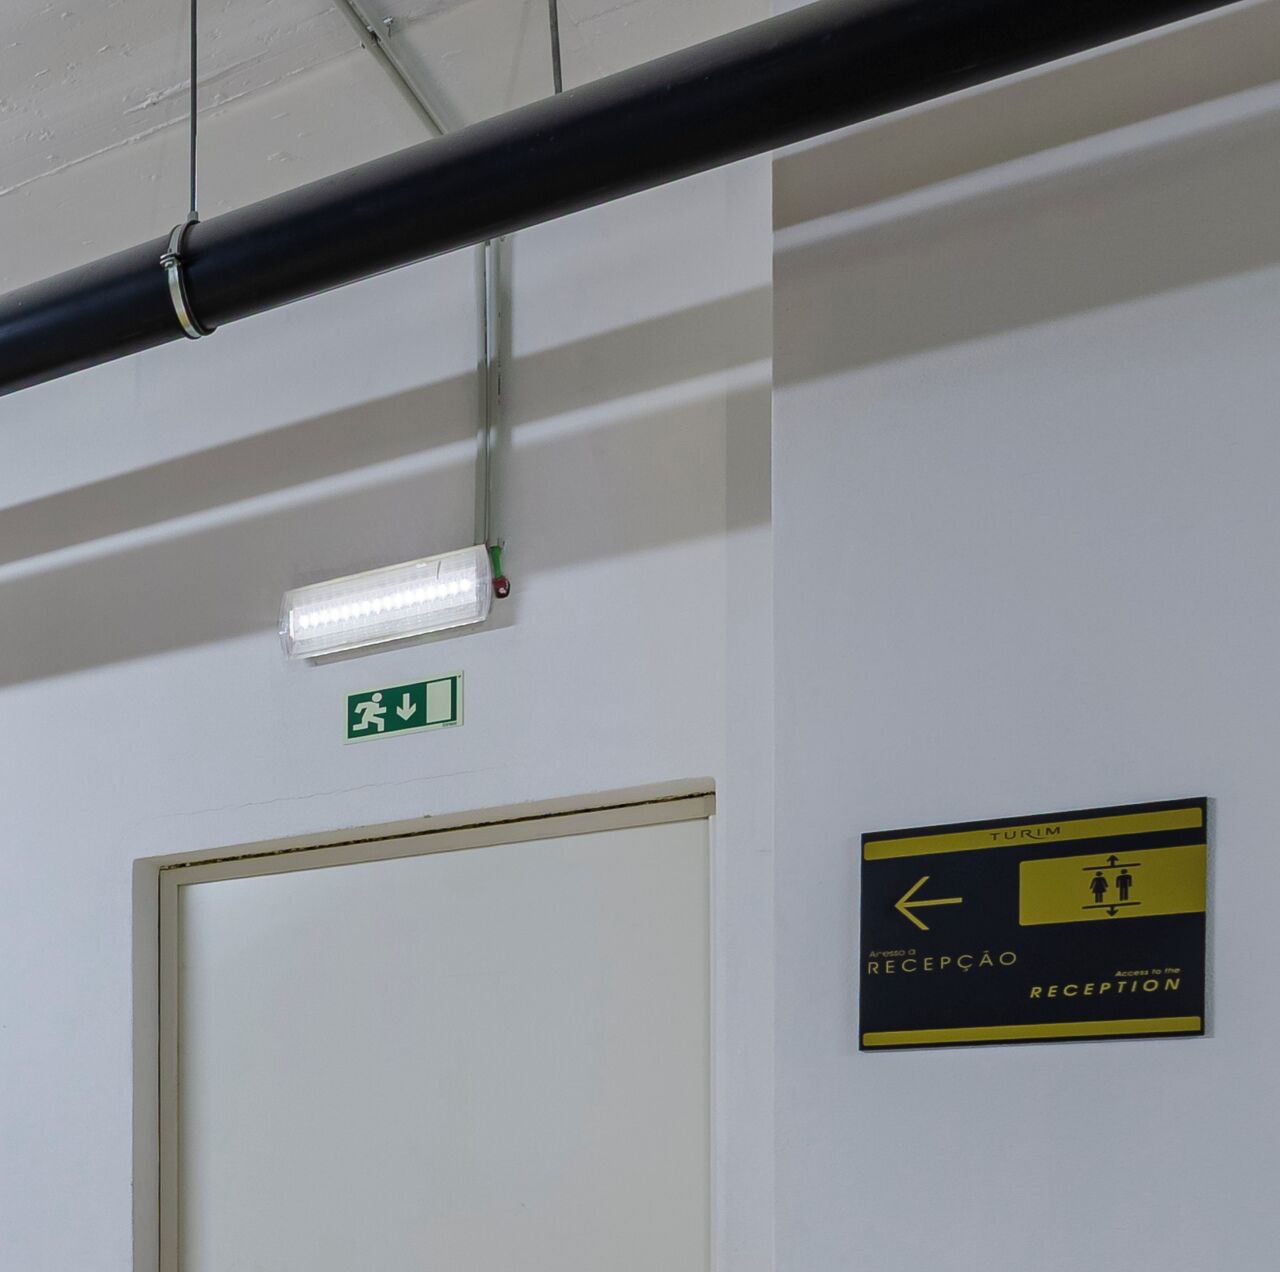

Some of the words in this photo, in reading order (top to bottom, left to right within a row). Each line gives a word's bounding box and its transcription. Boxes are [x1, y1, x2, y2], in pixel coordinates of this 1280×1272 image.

[989, 826, 1061, 841] TURIM
[867, 950, 1017, 975] RECEPÇÃO
[1114, 969, 1149, 977] Access
[1029, 978, 1181, 999] RECEPTION
